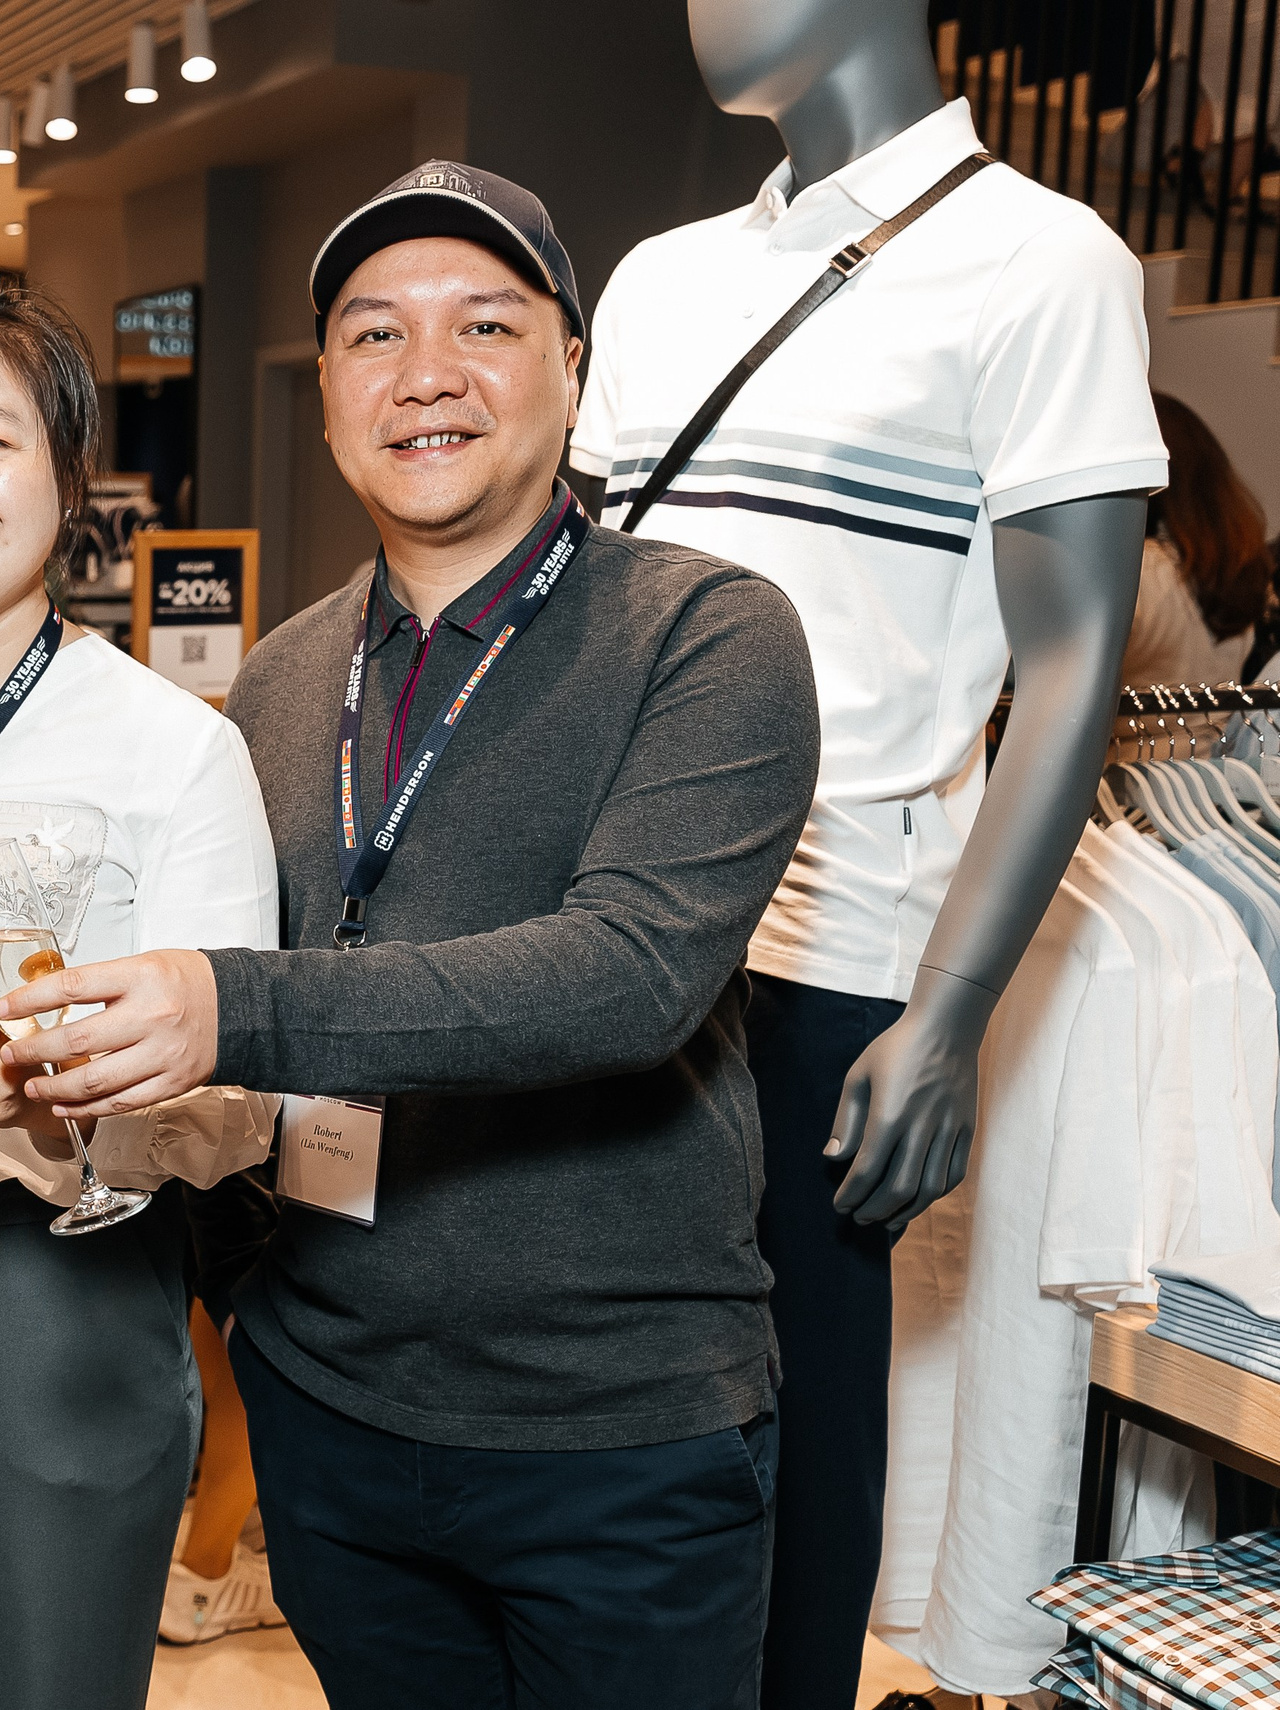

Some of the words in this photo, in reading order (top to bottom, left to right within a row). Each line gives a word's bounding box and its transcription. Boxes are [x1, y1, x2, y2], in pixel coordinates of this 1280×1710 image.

[531, 572, 547, 588] 30
[541, 540, 567, 573] YEARS
[539, 583, 550, 595] OF
[560, 543, 575, 565] STYLE
[5, 680, 20, 695] 30
[14, 648, 41, 680] YEARS
[13, 690, 23, 700] OF
[33, 652, 49, 672] STYLE
[351, 666, 362, 701] YEARS
[385, 750, 435, 833] HENDERSON
[320, 1097, 342, 1105] MOSCOW
[300, 1138, 316, 1150] (Lin
[317, 1142, 354, 1161] Wenfeng)
[313, 1124, 342, 1141] Robert
